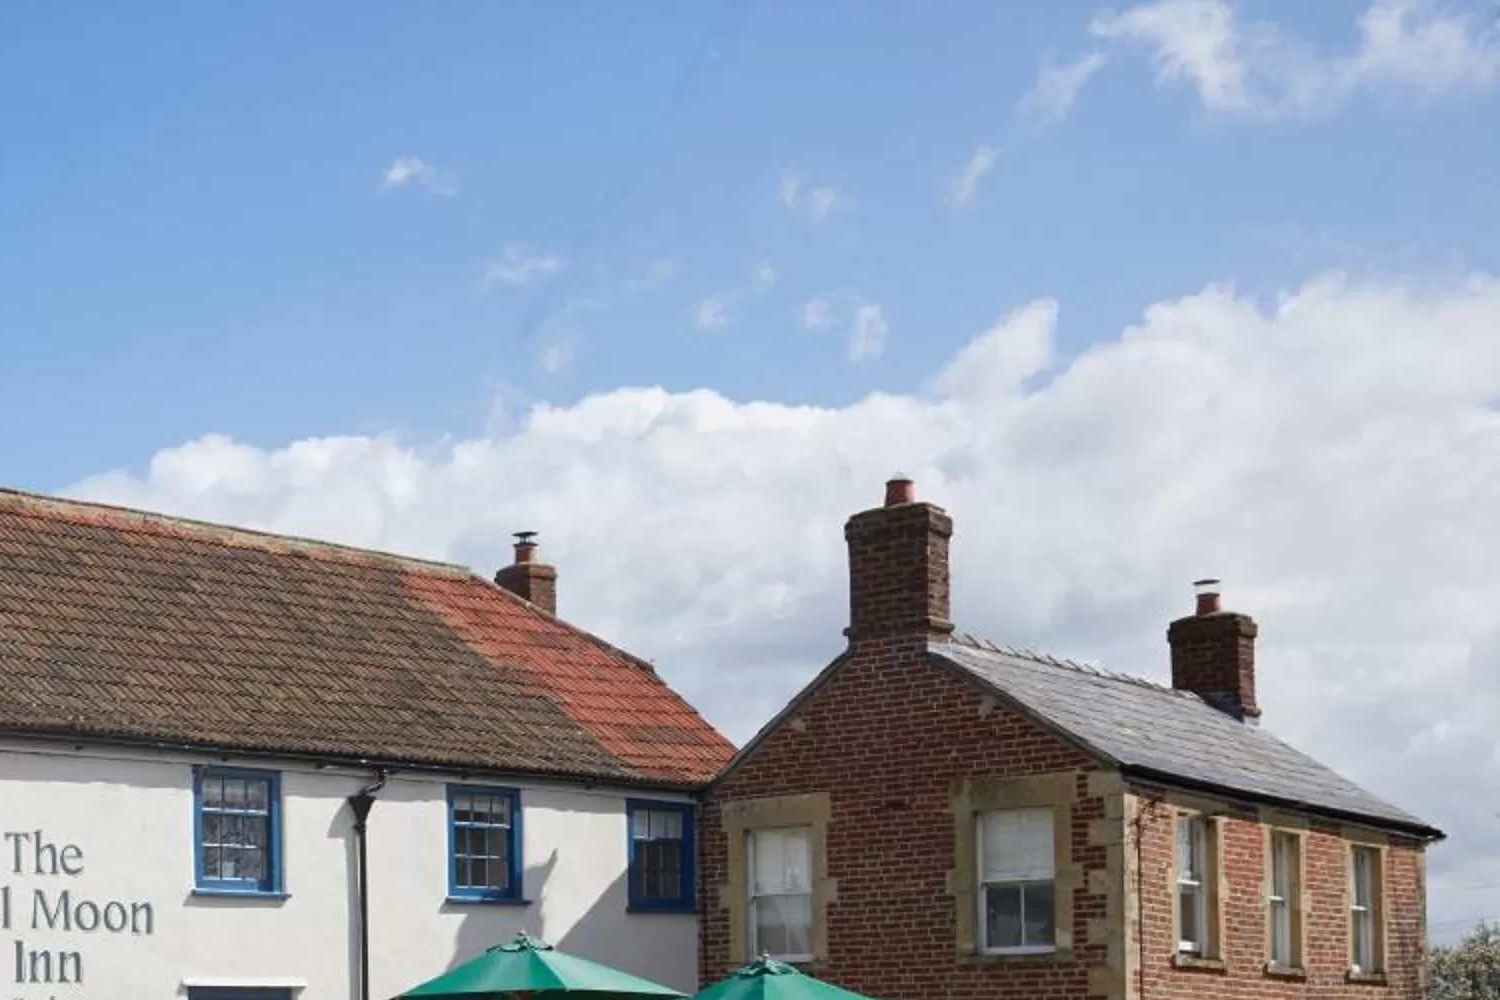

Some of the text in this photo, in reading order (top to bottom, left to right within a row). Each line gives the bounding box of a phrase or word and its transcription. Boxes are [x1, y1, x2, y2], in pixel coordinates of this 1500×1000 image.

[4, 829, 84, 875] The
[31, 888, 154, 935] Moon
[14, 939, 83, 983] Inn
